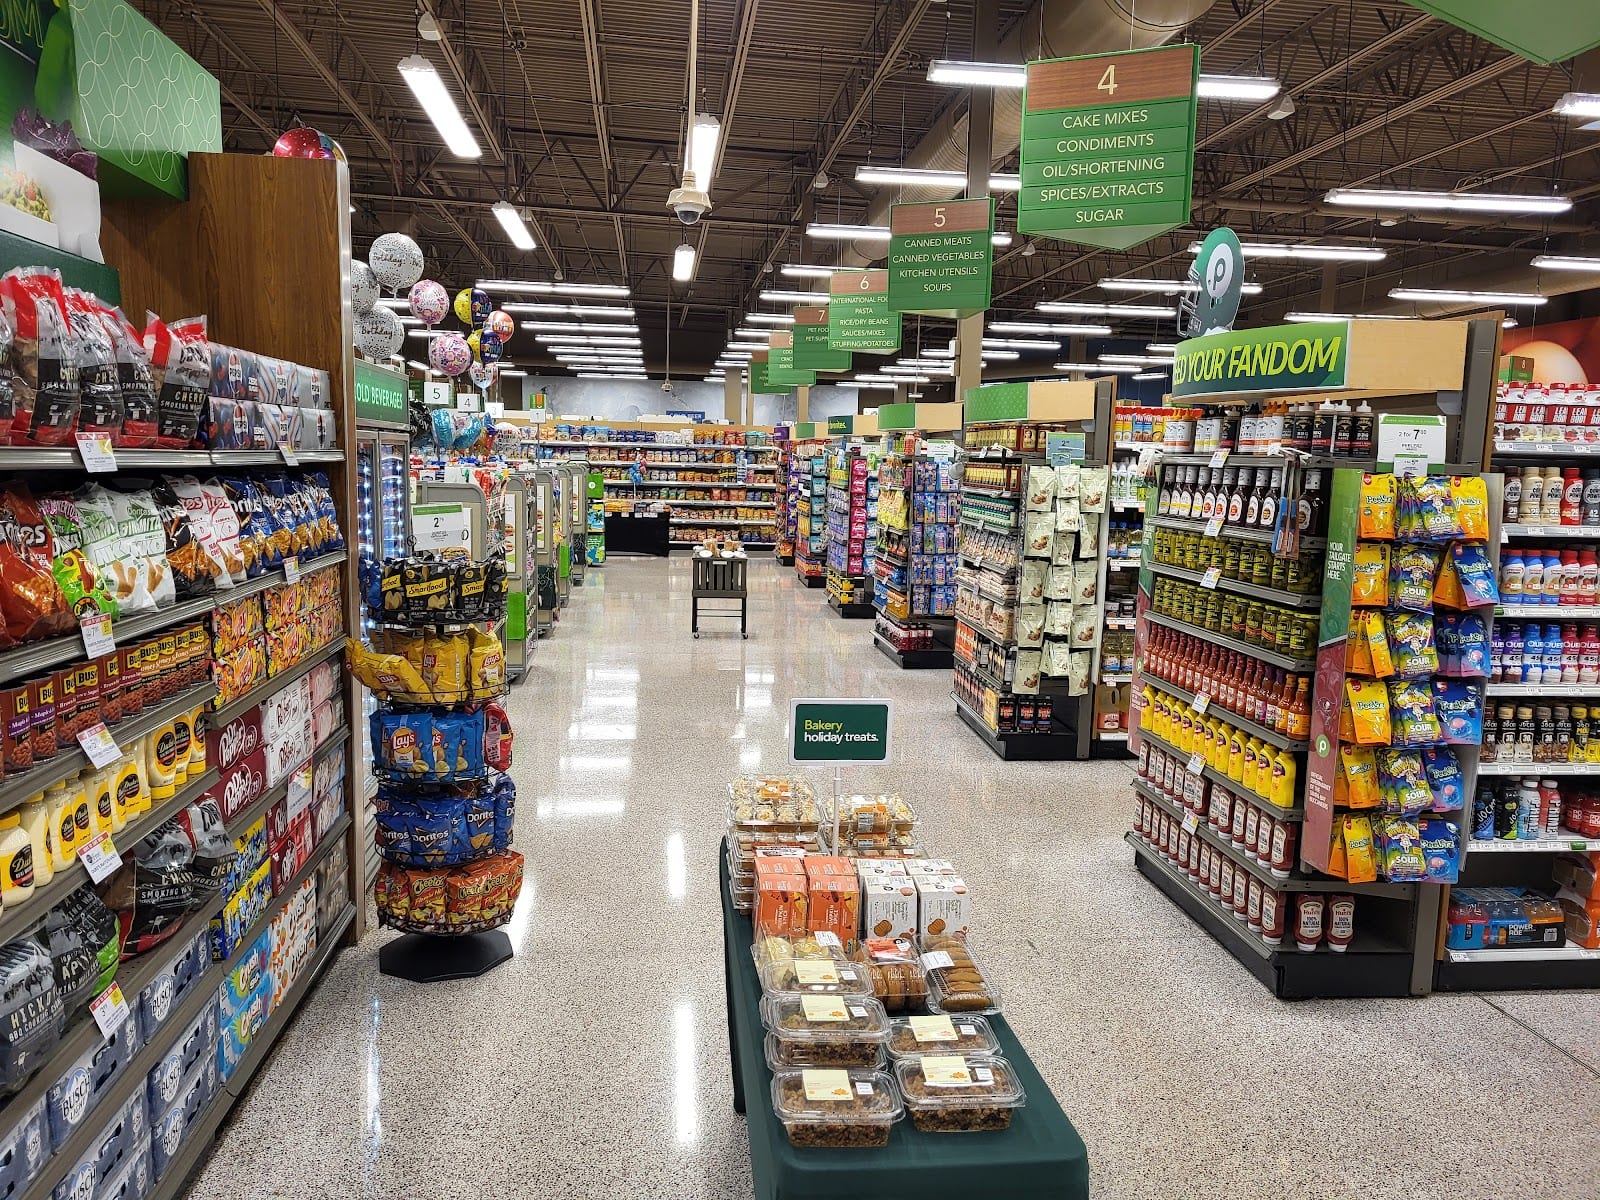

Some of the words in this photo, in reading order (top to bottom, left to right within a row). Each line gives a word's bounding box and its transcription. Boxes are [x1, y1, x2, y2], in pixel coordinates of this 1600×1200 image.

[1097, 65, 1118, 95] 4
[1063, 114, 1100, 129] CAKE
[1105, 110, 1148, 126] MIXES
[1057, 134, 1154, 153] CONDIMENTS
[1043, 158, 1164, 178] OIL/SHORTENING
[1041, 182, 1163, 202] SPICES/EXTRACTS
[934, 208, 946, 227] 5
[1076, 209, 1123, 223] SUGAR
[905, 239, 941, 247] CANNED
[944, 237, 971, 245] MEATS
[893, 255, 929, 263] CANNED
[932, 251, 984, 262] VEGETABLES
[900, 269, 936, 278] KITCHEN
[939, 267, 978, 276] UTENSILS
[860, 275, 869, 290] 6
[924, 283, 951, 291] SOUPS
[818, 310, 825, 322] 7
[361, 325, 393, 337] Birthday
[1187, 348, 1225, 383] YOUR
[1228, 336, 1342, 379] FANDOM
[229, 367, 241, 377] PEPSI
[356, 383, 370, 403] OLD
[372, 387, 403, 410] BEVERAGES
[433, 388, 441, 399] 5
[464, 399, 471, 408] 4
[492, 406, 497, 415] 3
[235, 420, 248, 430] PEPSI
[1413, 430, 1420, 440] 7
[127, 507, 151, 516] Doritos
[434, 518, 439, 527] 2
[1430, 516, 1451, 524] SOUR
[1330, 543, 1343, 551] YOUR
[1329, 551, 1351, 562] TAILGATE
[1327, 561, 1346, 571] STARTS
[409, 581, 444, 594] Smartfood
[464, 583, 484, 593] Smar
[1403, 588, 1427, 597] SOUR
[189, 630, 202, 640] BUS
[484, 654, 500, 666] Lay's
[1406, 657, 1430, 666] SOUR
[78, 671, 96, 683] BUS
[19, 698, 28, 709] BU
[804, 720, 843, 733] Bakery
[393, 732, 415, 750] Lay's
[804, 732, 843, 744] holiday
[845, 731, 878, 742] treats.
[220, 728, 245, 767] Pepper
[225, 775, 250, 815] Pepper
[1406, 789, 1427, 801] SOUR
[1546, 799, 1561, 832] PRIME
[412, 829, 448, 843] Doritos
[1395, 856, 1419, 864] SOUR
[413, 876, 446, 895] Cheetos
[142, 886, 178, 899] SMOKING
[240, 948, 258, 992] Crush
[151, 981, 173, 1016] BUSCH
[242, 994, 261, 1038] Crush
[9, 1027, 23, 1041] BBQ
[161, 1060, 182, 1098] BUSCH
[61, 1072, 91, 1119] BUSCH
[69, 1098, 87, 1122] LIGHT
[163, 1114, 183, 1152] BUSCH
[68, 1162, 97, 1200] BUSCH
